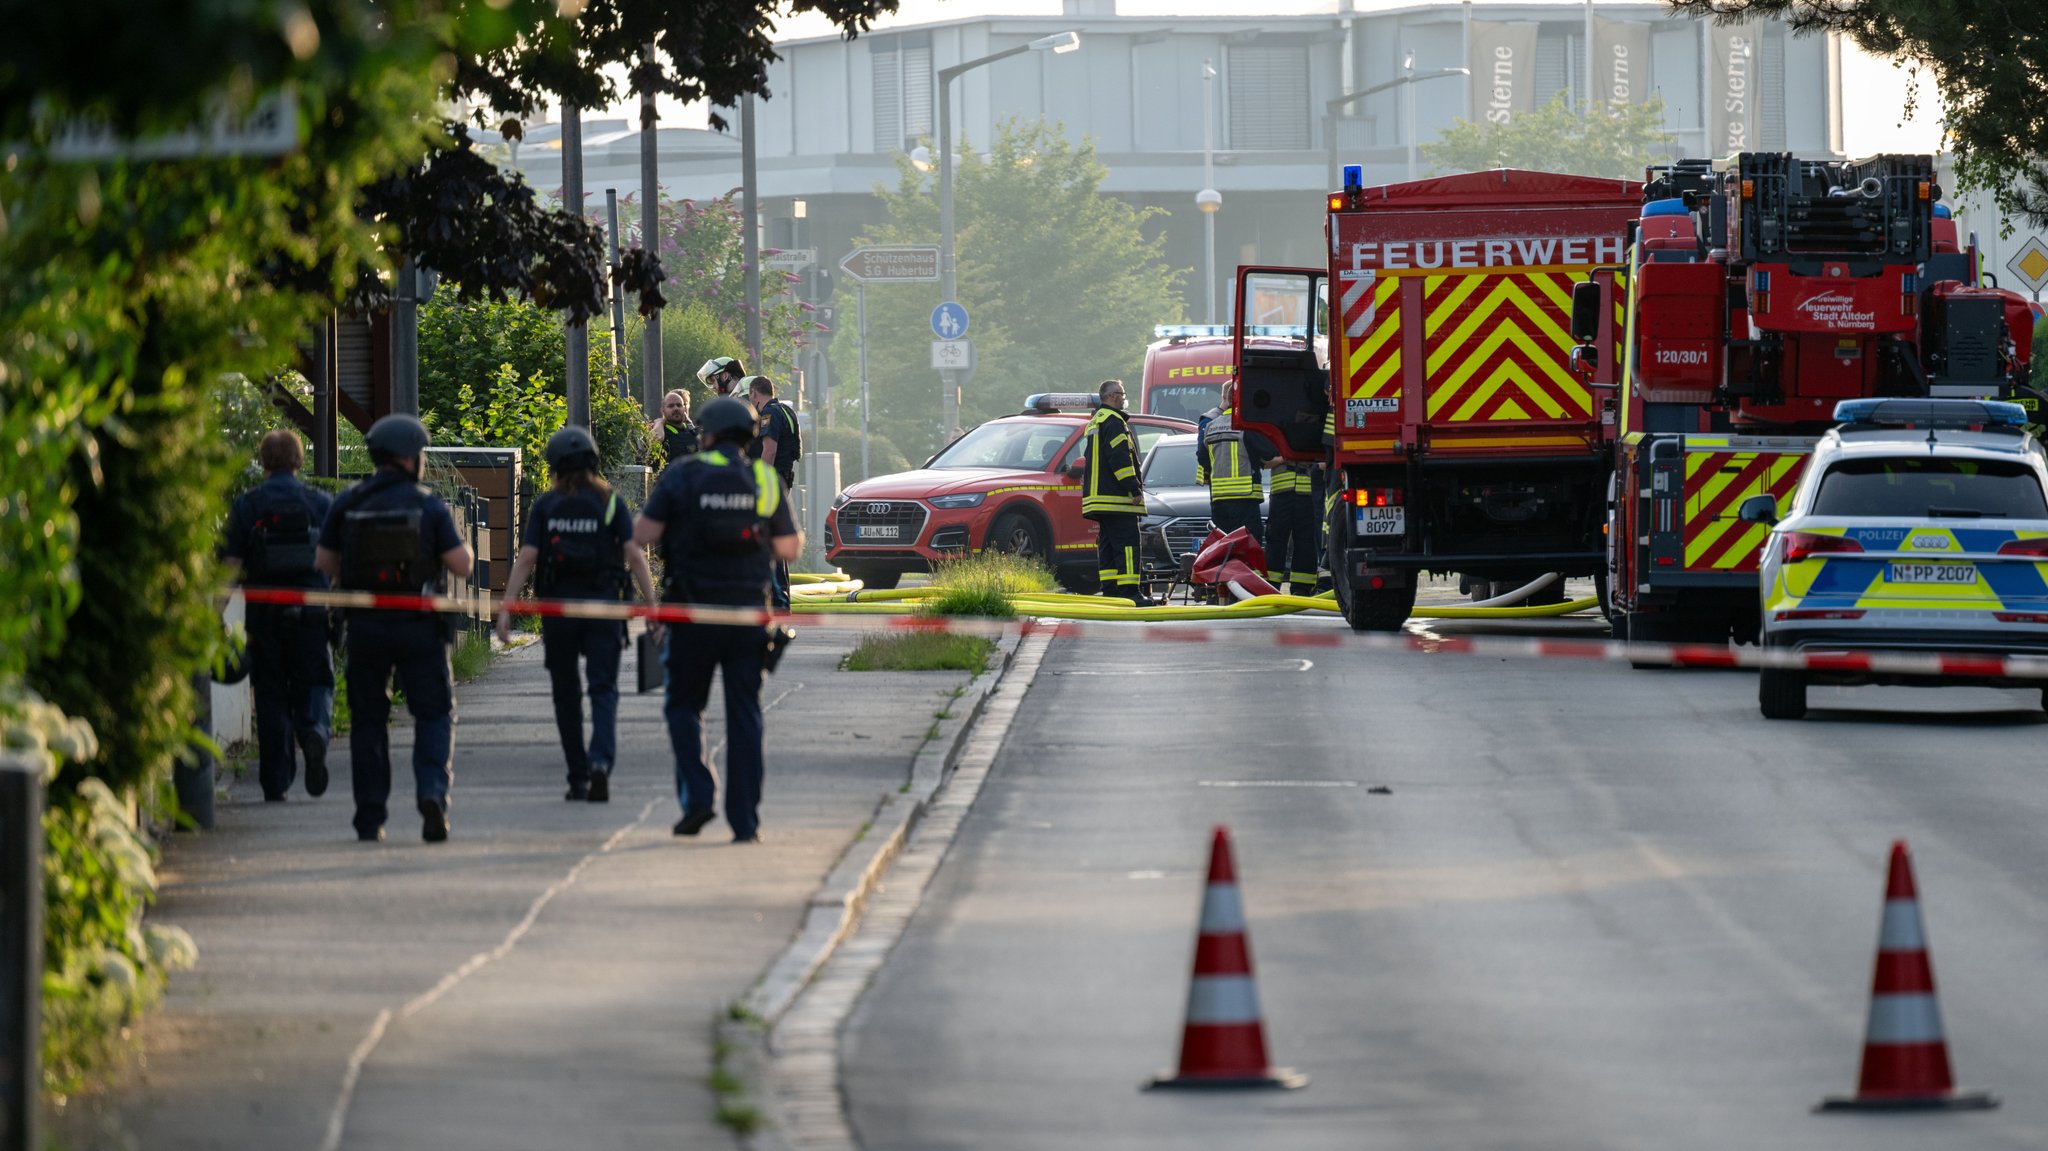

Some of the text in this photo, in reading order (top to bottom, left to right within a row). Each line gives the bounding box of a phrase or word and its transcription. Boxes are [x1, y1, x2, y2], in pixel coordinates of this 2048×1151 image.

[1725, 36, 1746, 114] Sterne
[1486, 46, 1513, 124] Sterne
[864, 253, 935, 264] Schützenhaus
[1352, 237, 1624, 270] FEUERWEH
[865, 265, 935, 277] S.G. Hubertus
[1813, 311, 1875, 320] Stadt Altdorf
[1838, 320, 1875, 330] Nürnberg
[1656, 350, 1708, 365] 120/30/1
[1168, 365, 1237, 379] FEUER
[1162, 387, 1207, 398] 14/14/1
[1347, 399, 1397, 407] DAUTEL
[700, 493, 755, 511] POLIZEI
[1370, 508, 1394, 520] LAU
[547, 518, 598, 533] POLIZEI
[1366, 521, 1396, 533] 8097
[860, 527, 898, 537] LAU NL 112
[1858, 530, 1904, 541] POLIZEI
[1893, 565, 1974, 581] N PP 2007
